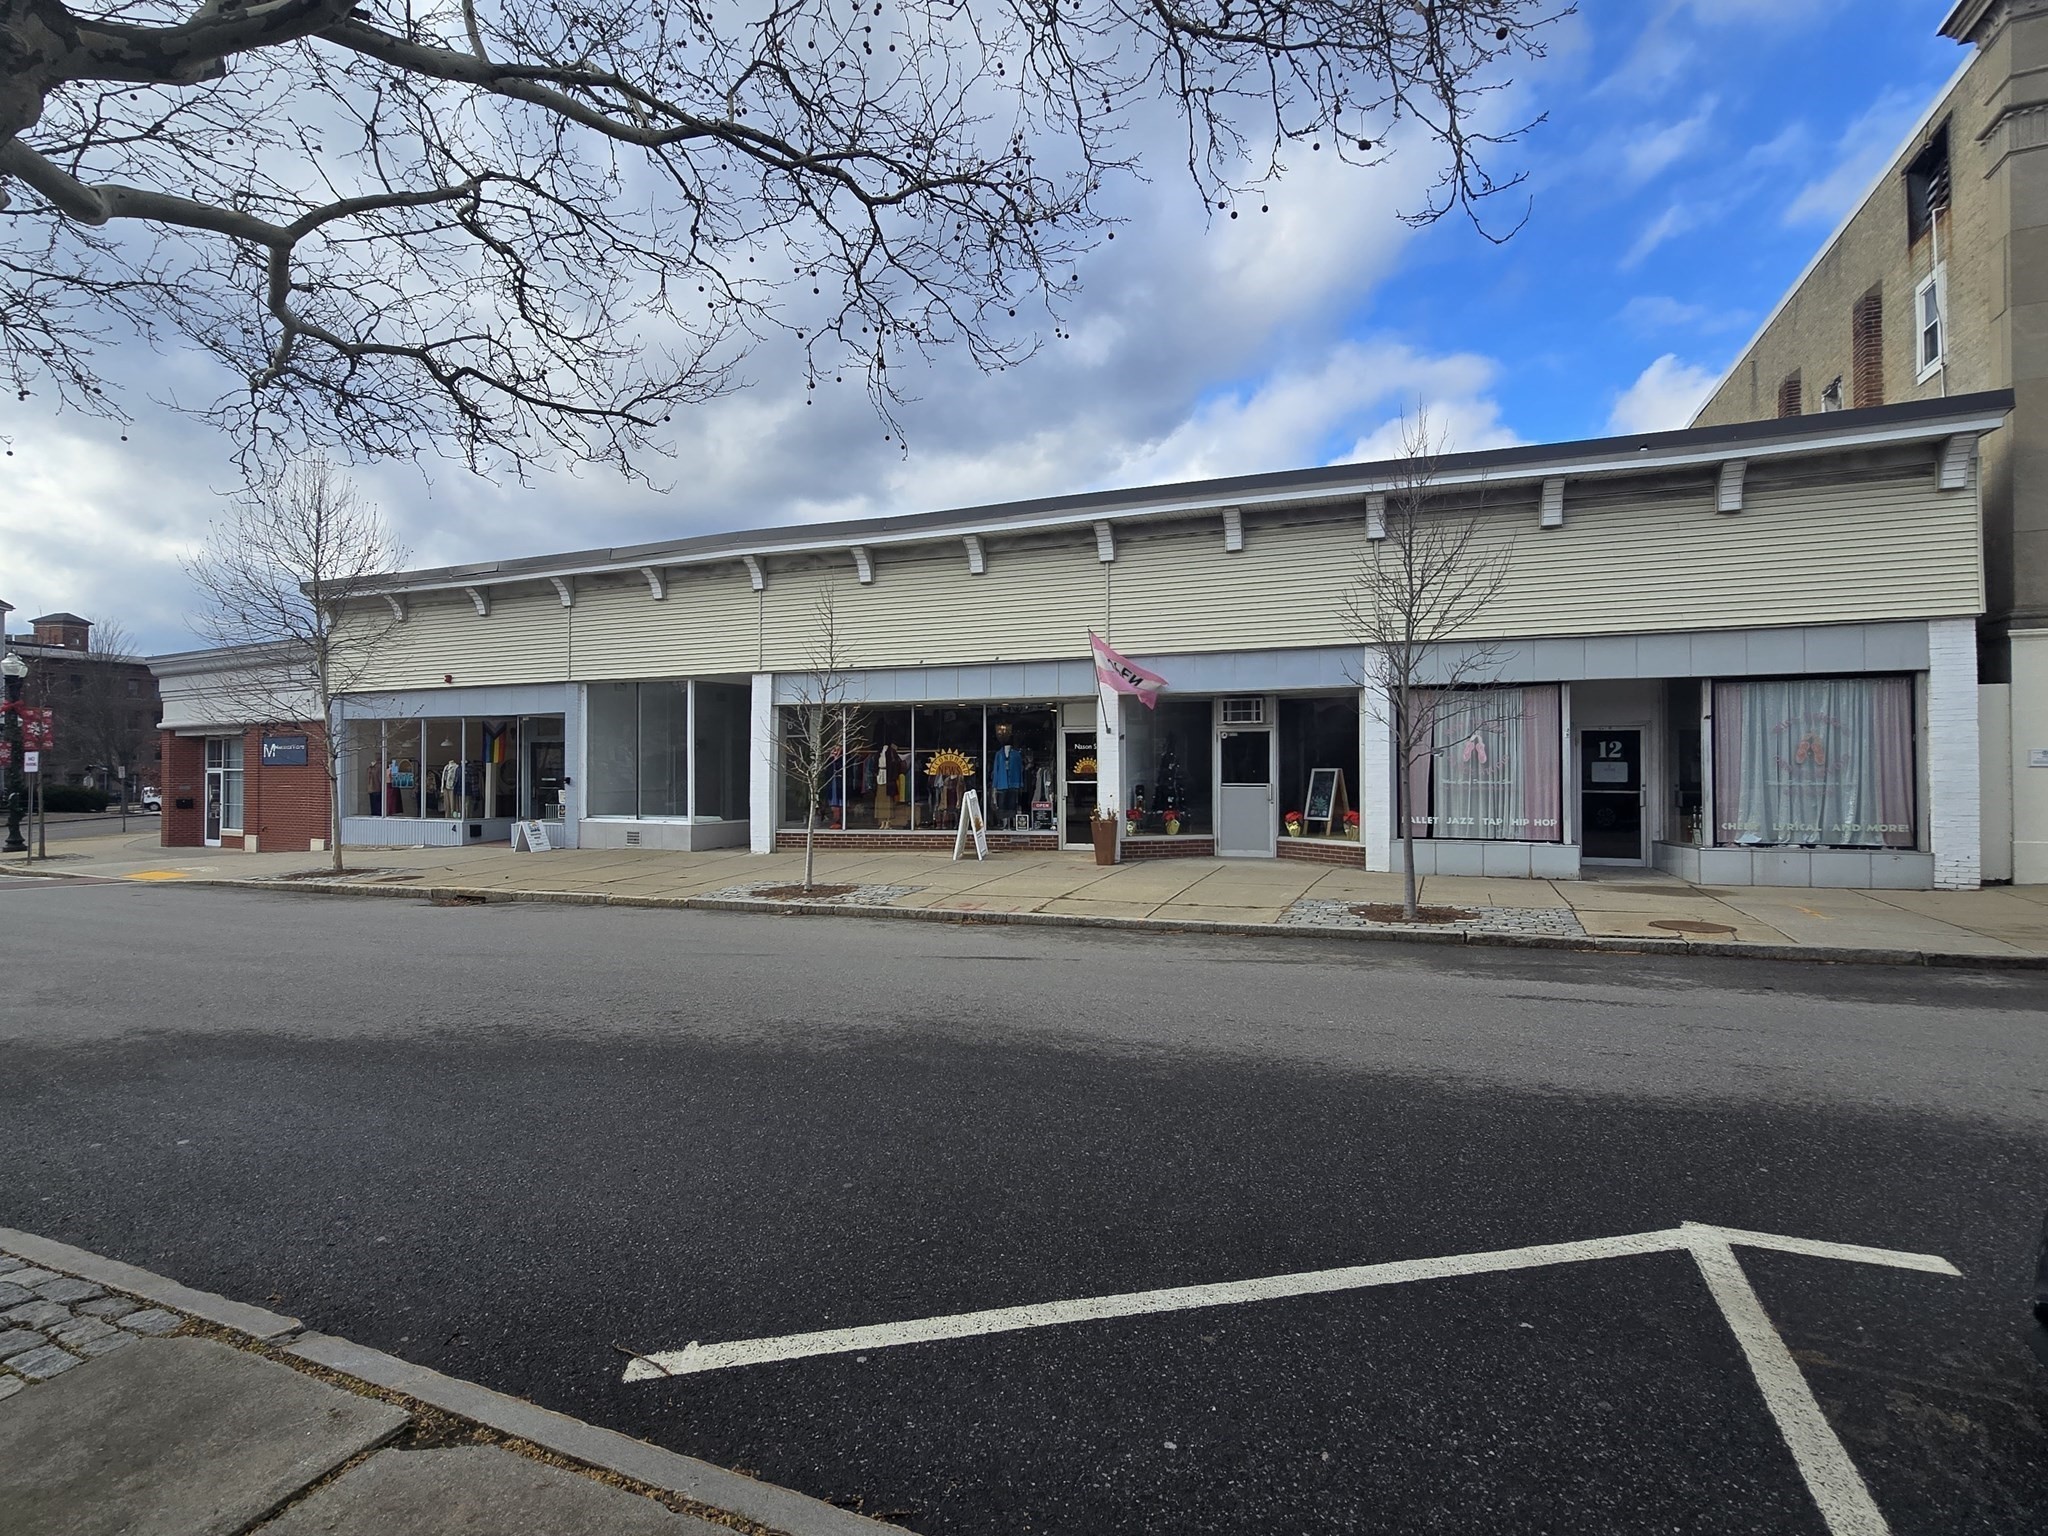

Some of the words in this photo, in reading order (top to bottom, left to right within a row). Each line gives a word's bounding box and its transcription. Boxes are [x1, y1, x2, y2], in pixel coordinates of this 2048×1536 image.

[1598, 740, 1623, 758] 12
[930, 754, 969, 774] SECONDHAND
[1446, 816, 1475, 825] JAZZ
[1482, 817, 1503, 826] TAP
[1511, 818, 1530, 827] HIP
[1533, 818, 1558, 827] HOP
[1773, 822, 1822, 832] LYRICAL
[1832, 823, 1861, 832] AND
[1866, 823, 1910, 833] MORE!
